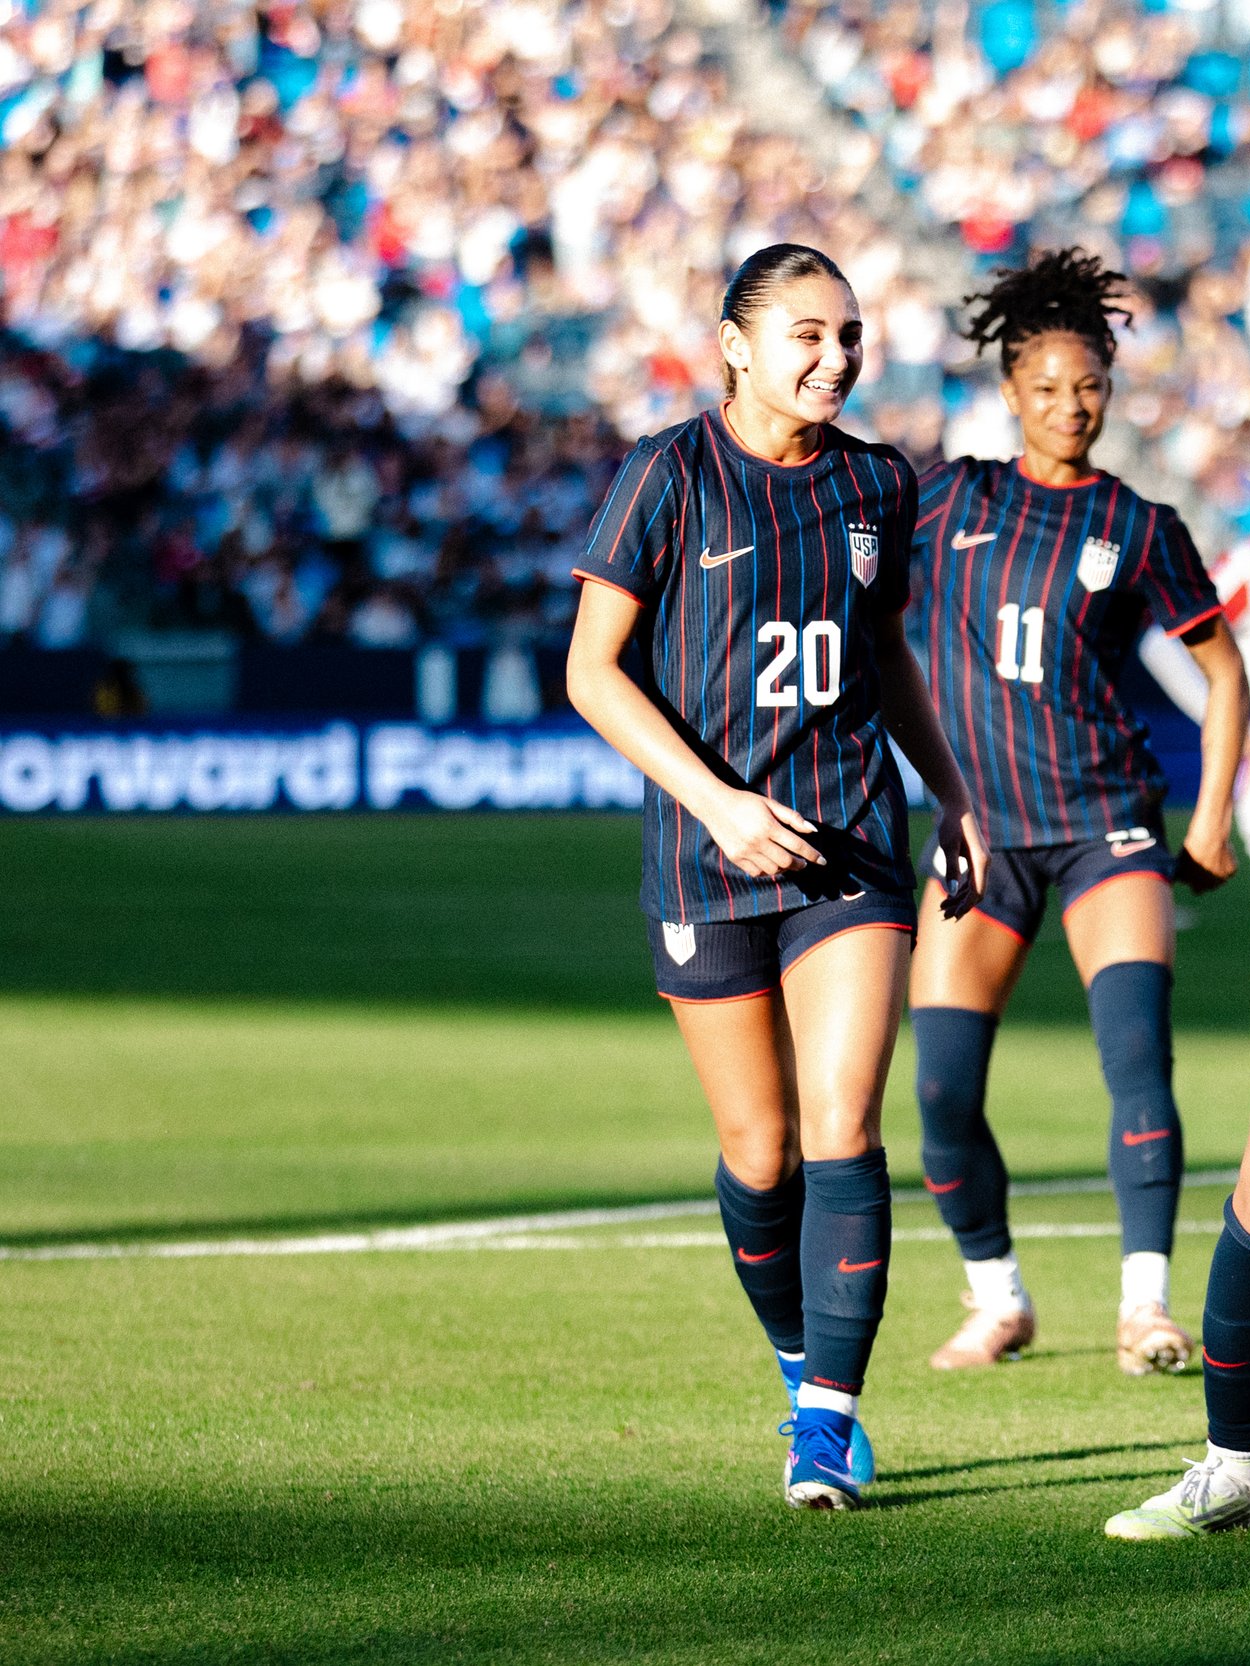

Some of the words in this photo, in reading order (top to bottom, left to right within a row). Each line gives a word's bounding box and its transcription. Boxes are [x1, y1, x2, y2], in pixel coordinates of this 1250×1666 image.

[853, 536, 877, 557] USA
[756, 620, 841, 707] 20
[996, 603, 1044, 683] 11
